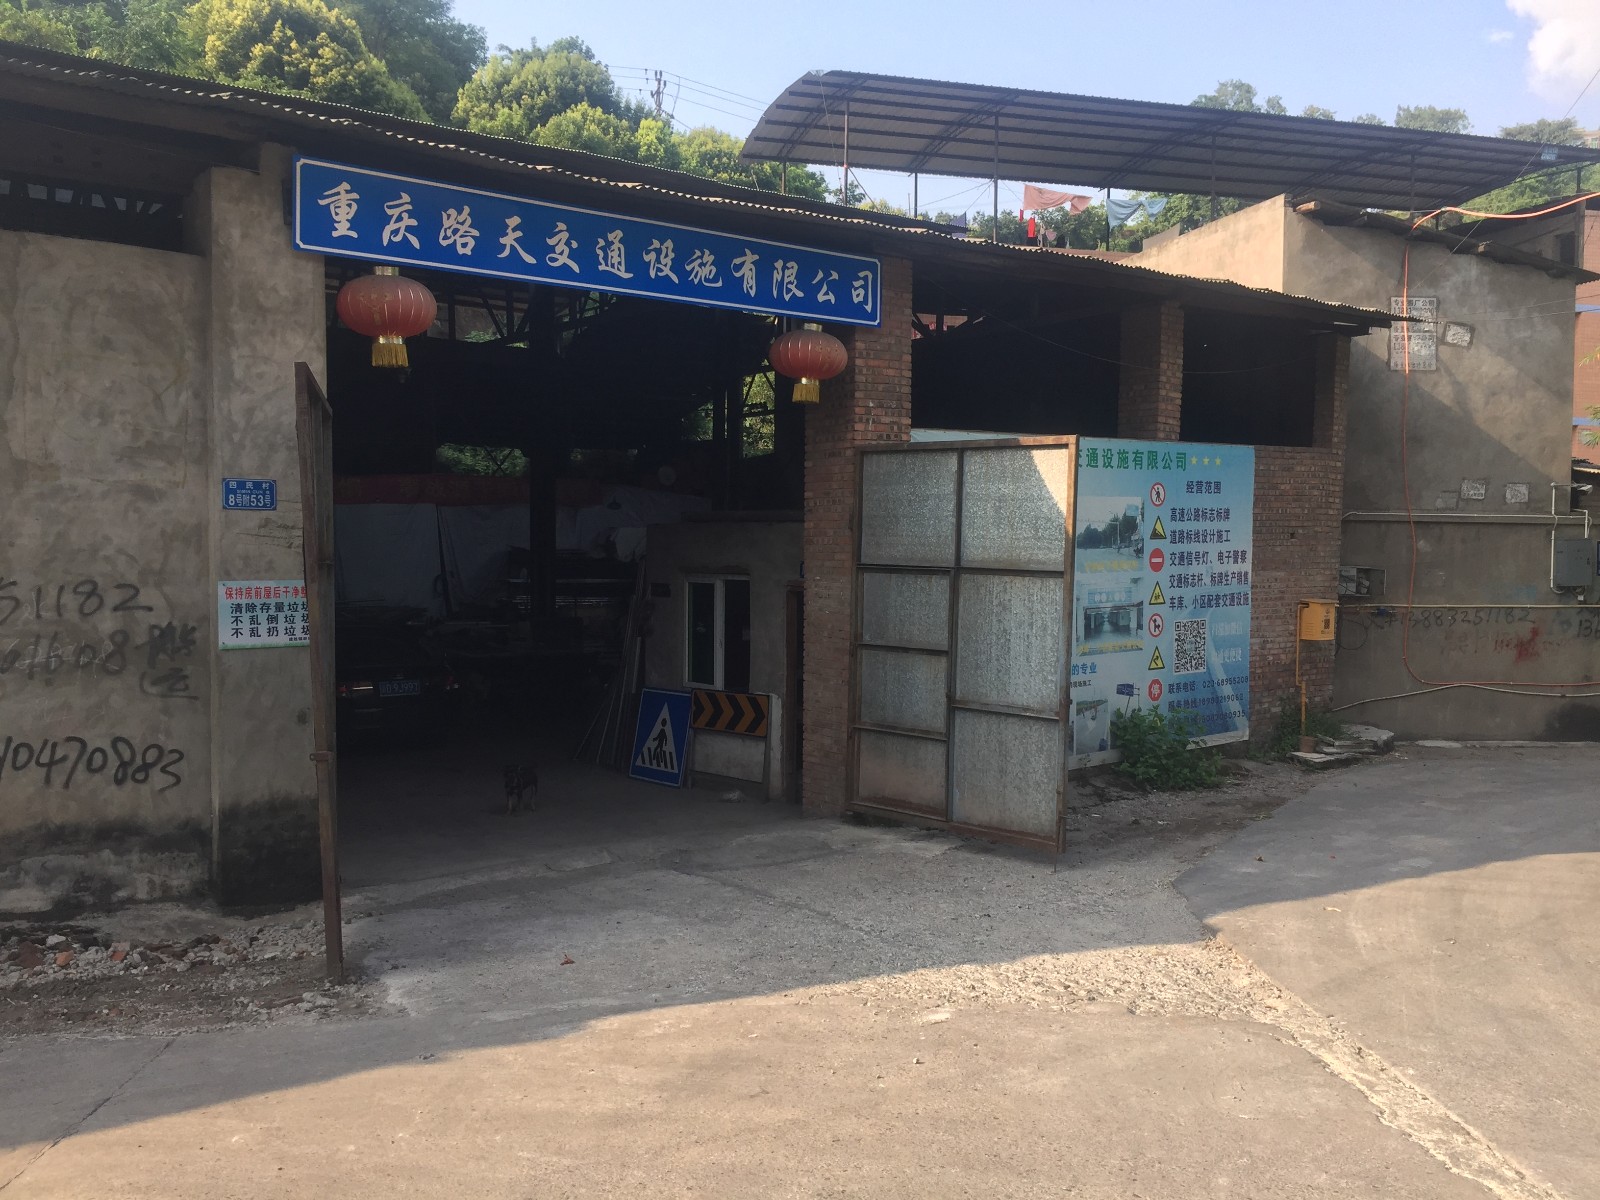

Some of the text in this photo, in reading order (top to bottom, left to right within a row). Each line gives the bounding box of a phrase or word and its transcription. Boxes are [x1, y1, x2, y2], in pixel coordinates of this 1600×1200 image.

[316, 180, 874, 314] 重庆路天交通设施有限公司
[1186, 481, 1222, 494] 经营范围
[228, 494, 272, 507] 8号附53号
[1170, 507, 1231, 523] 高速公路标志标牌
[1169, 529, 1231, 544] 道路标线设计施工
